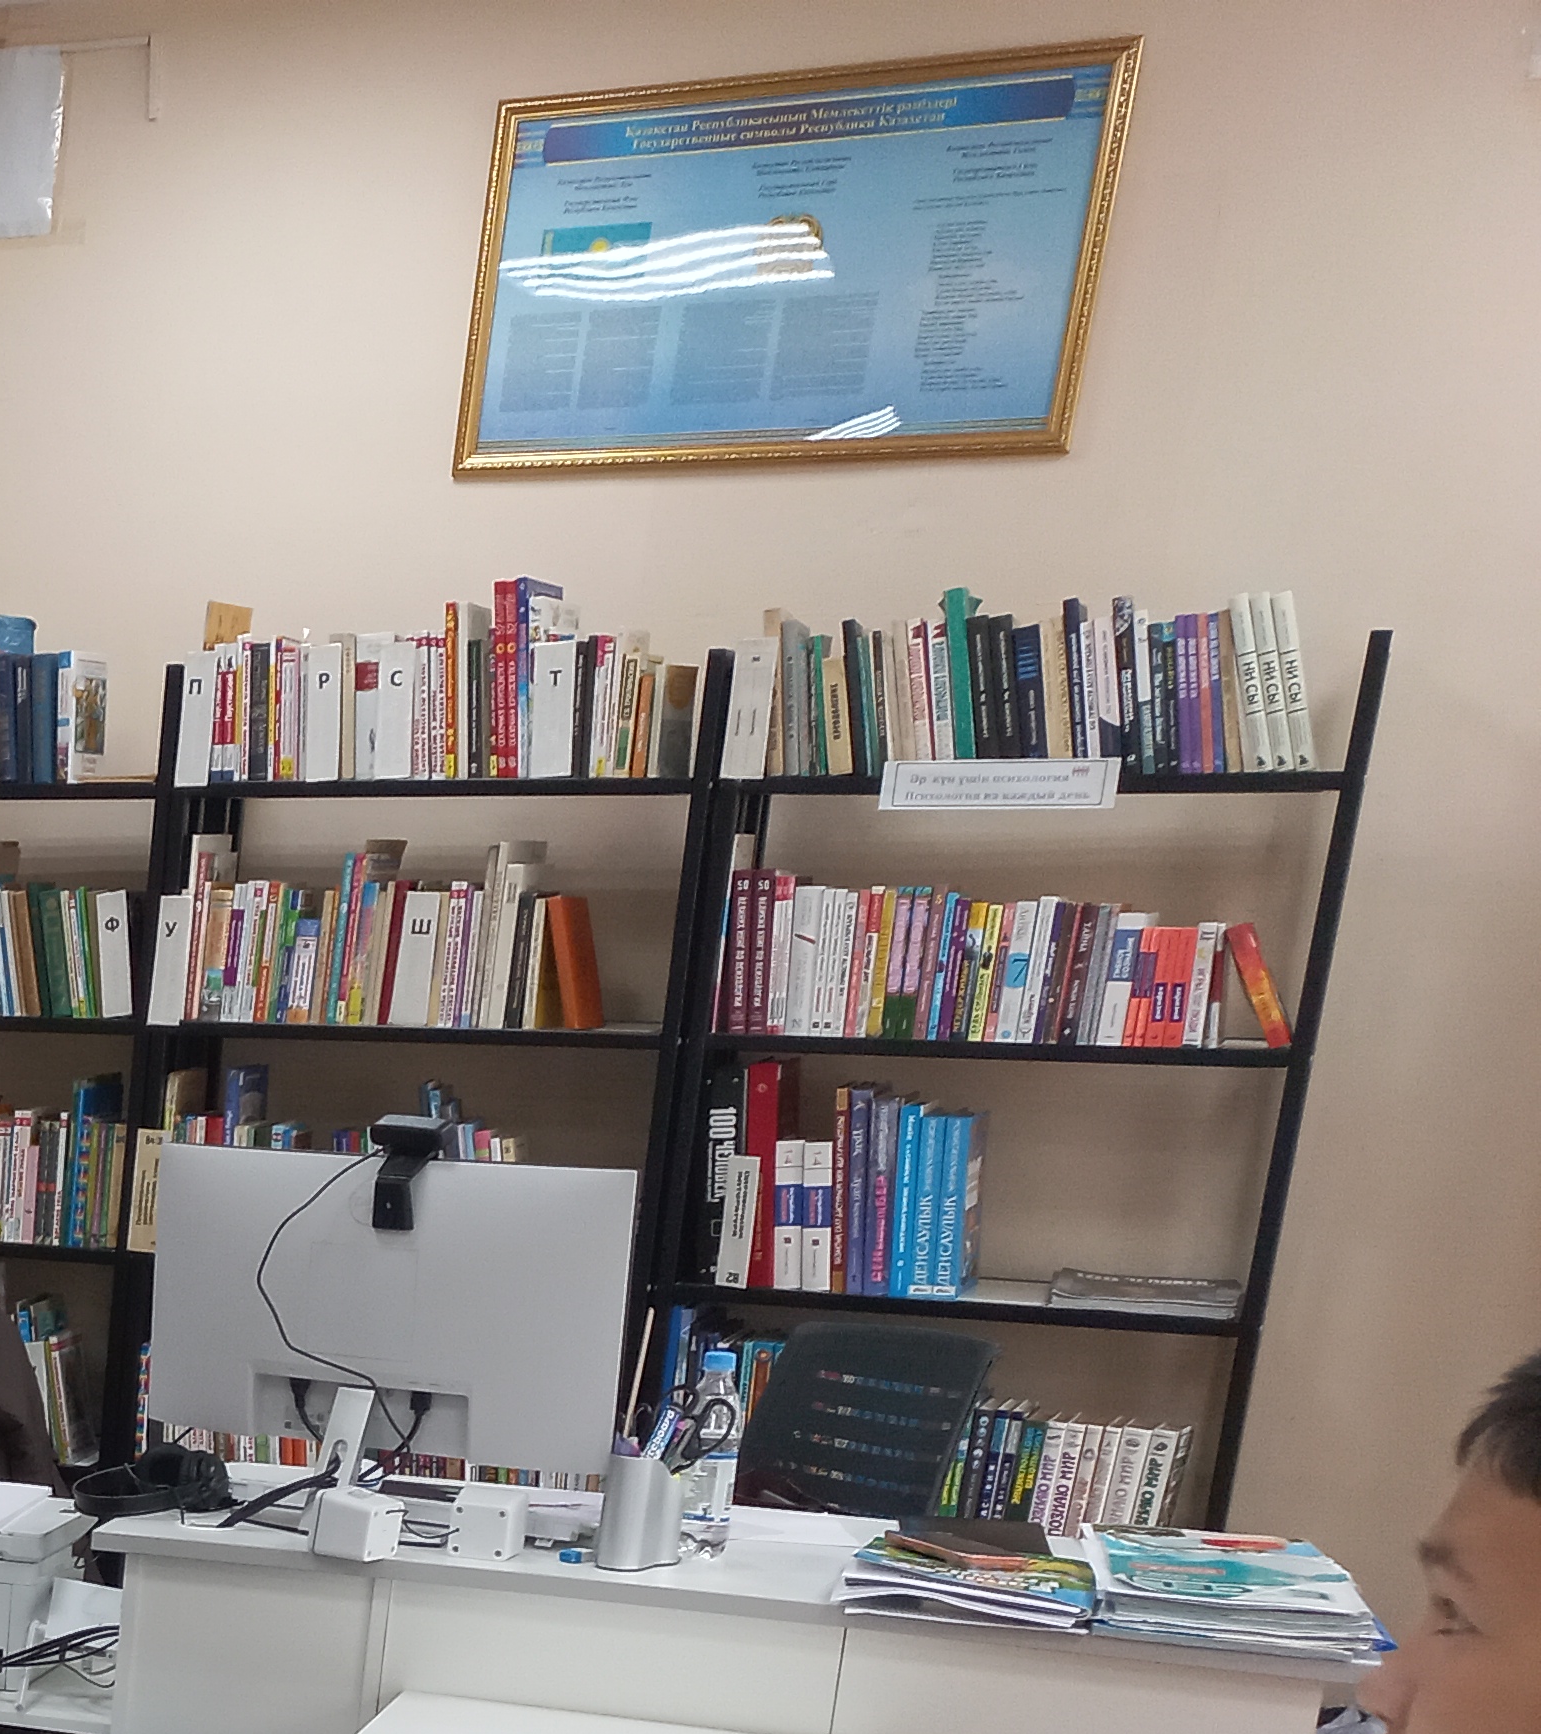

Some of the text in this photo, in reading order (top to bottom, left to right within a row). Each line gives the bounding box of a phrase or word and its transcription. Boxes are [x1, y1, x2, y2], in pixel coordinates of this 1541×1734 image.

[189, 678, 202, 695] П
[319, 673, 329, 689] Р
[391, 670, 402, 686] С
[550, 669, 563, 687] Т
[104, 915, 120, 933] Ф
[164, 920, 178, 937] У
[411, 917, 432, 936] Ш
[709, 1107, 737, 1138] 100
[1047, 1451, 1077, 1537] ПОЗНАЮ МИР
